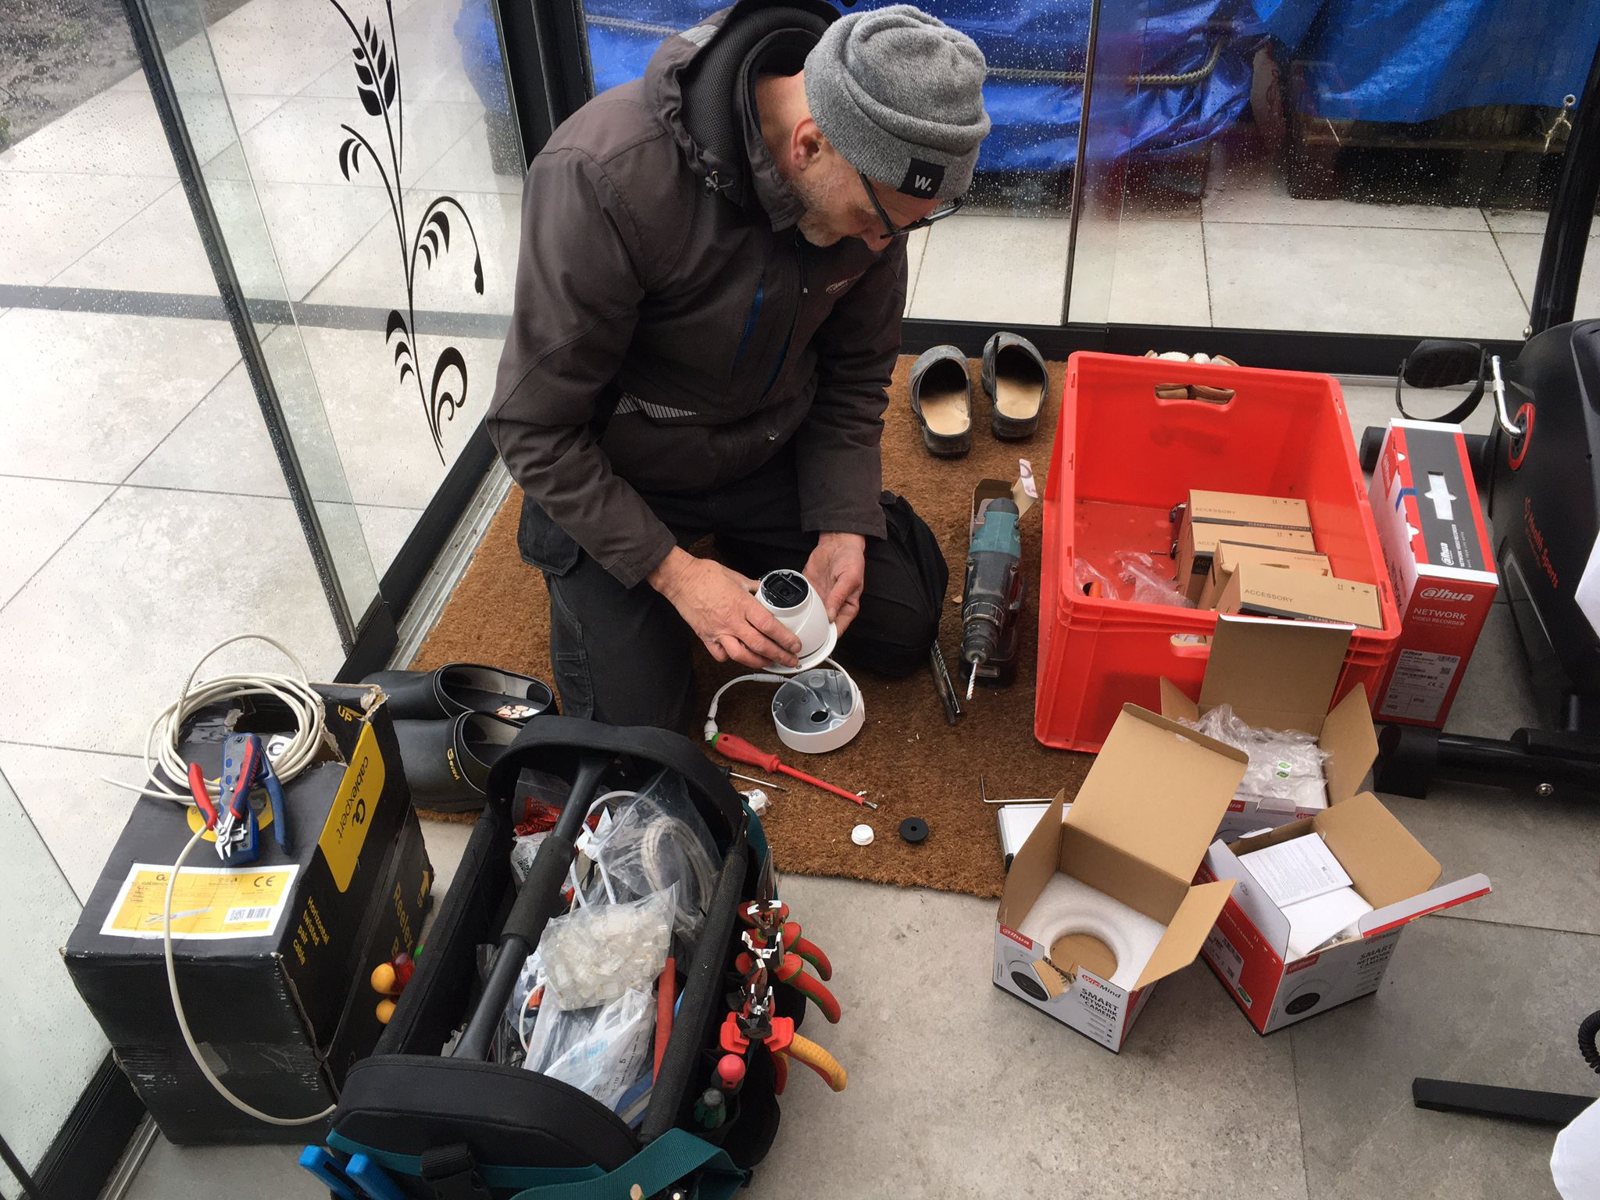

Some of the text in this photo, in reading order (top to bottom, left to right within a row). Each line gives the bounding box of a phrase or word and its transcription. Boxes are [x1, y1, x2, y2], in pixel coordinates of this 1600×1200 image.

[914, 174, 932, 192] W.
[1244, 588, 1293, 603] ACCESSORY
[1413, 607, 1469, 620] NETWORK
[337, 705, 353, 723] UP
[336, 756, 369, 840] cablexpert
[1079, 993, 1118, 1017] NETWORK
[1081, 988, 1120, 1011] SMART
[1084, 1001, 1117, 1021] CAMERA
